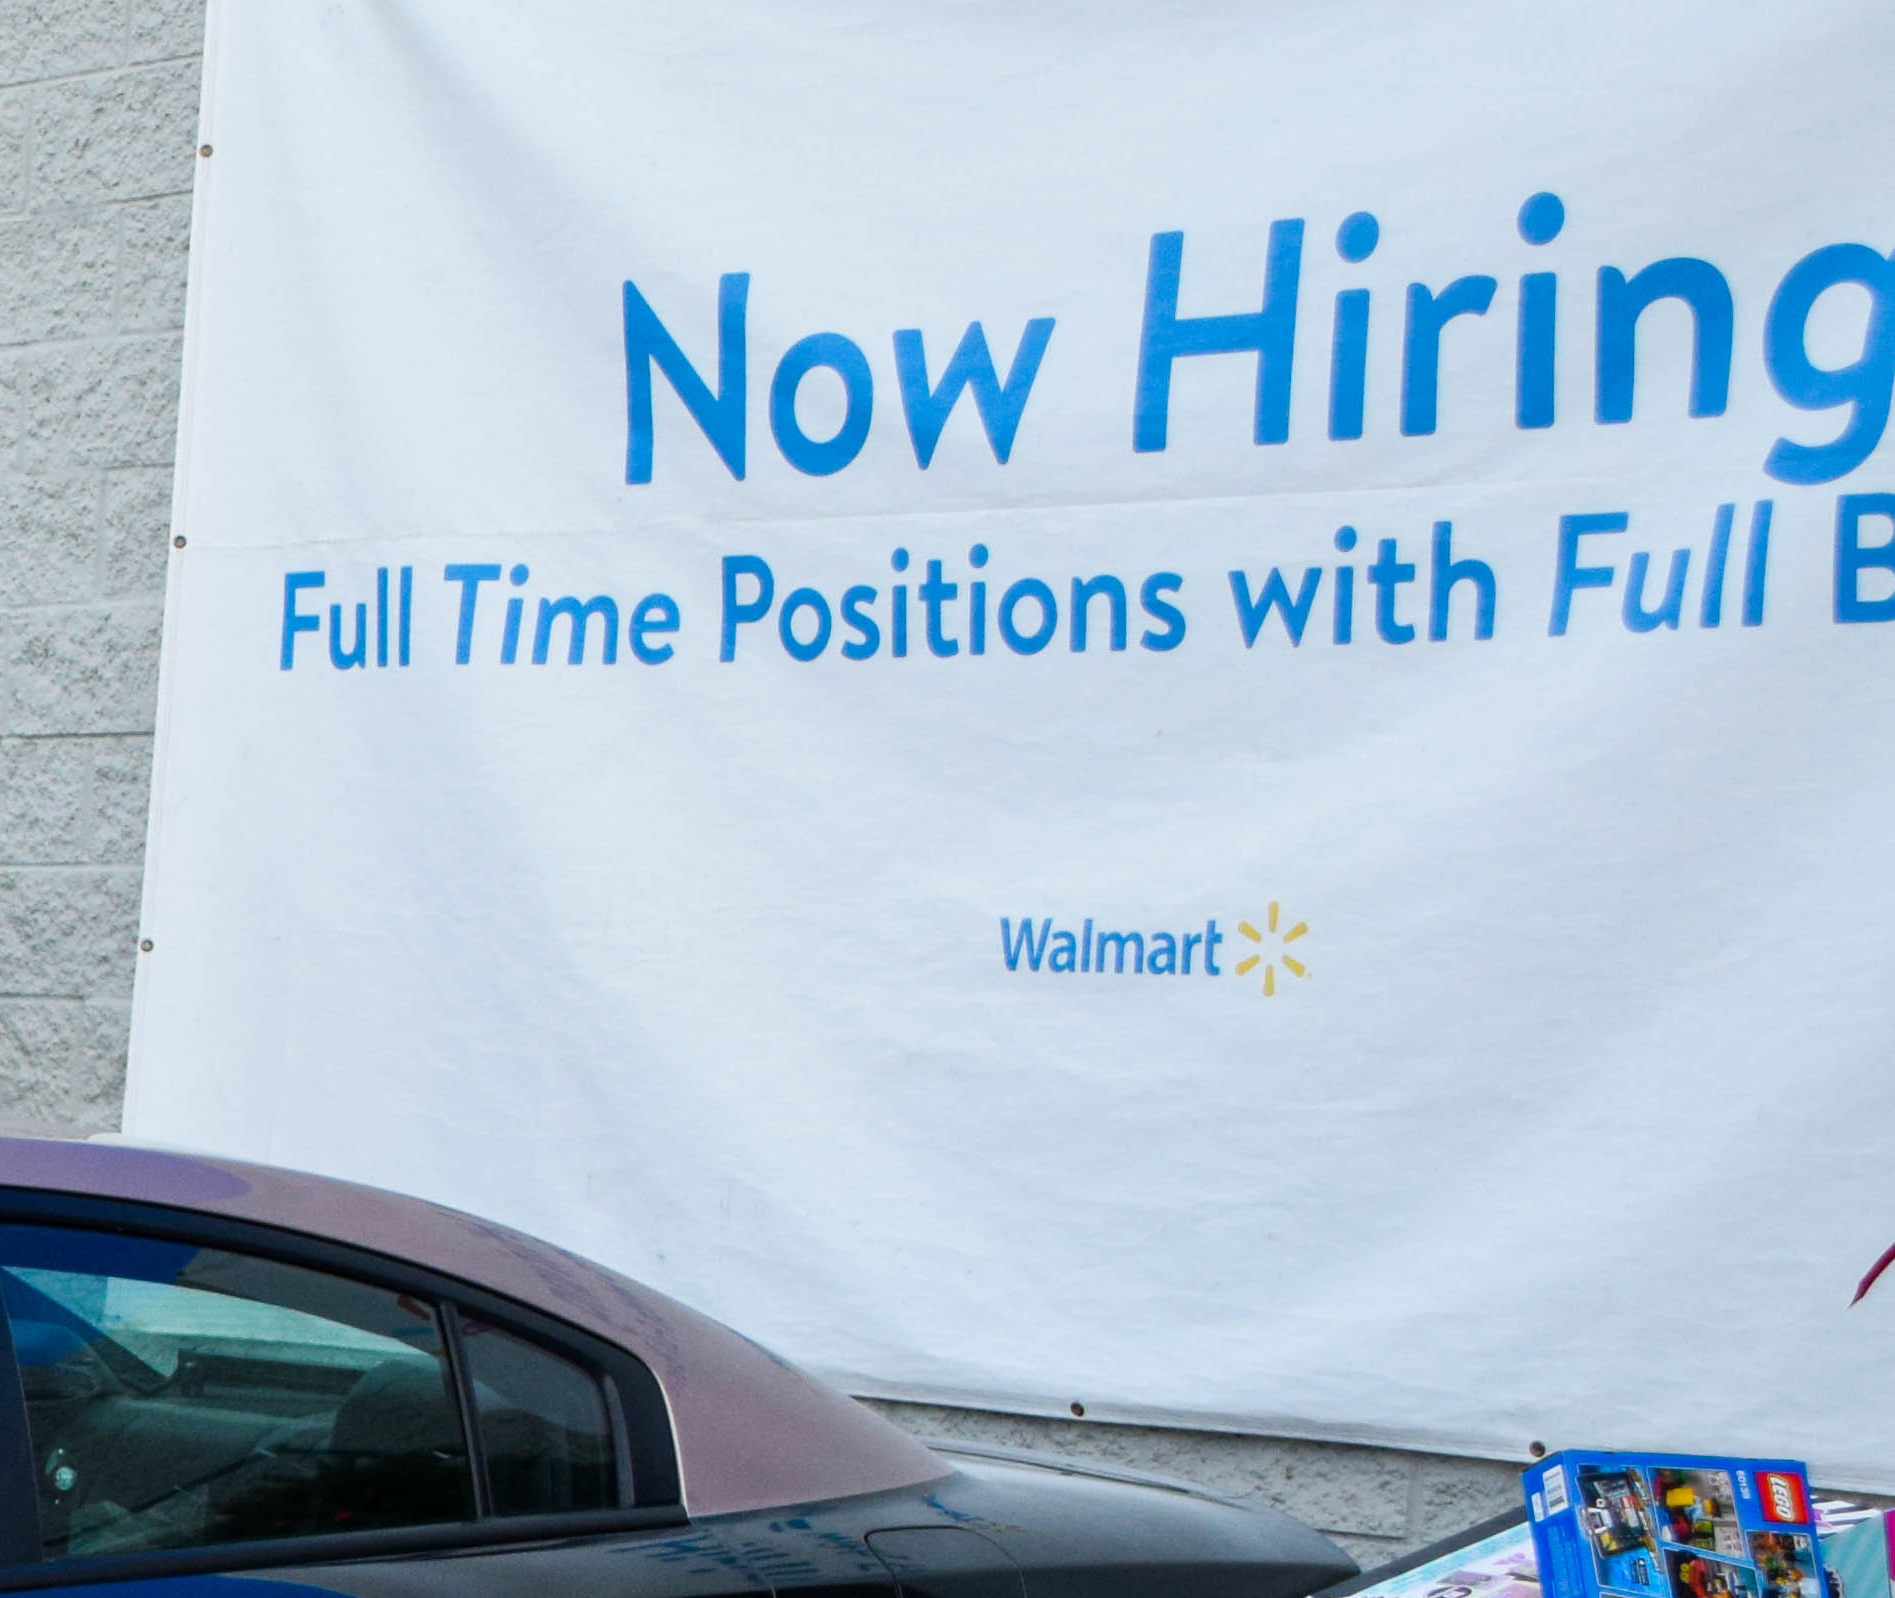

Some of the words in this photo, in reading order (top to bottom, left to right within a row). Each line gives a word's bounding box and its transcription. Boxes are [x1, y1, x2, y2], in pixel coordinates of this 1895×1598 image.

[622, 271, 1057, 486] Now
[1132, 191, 1895, 486] Hiring
[280, 565, 413, 670] Full
[444, 562, 681, 665] Time
[719, 543, 1188, 662] Positions
[1229, 519, 1497, 647] with
[1549, 498, 1774, 636] Full
[998, 914, 1224, 978] Walmart
[1767, 1474, 1795, 1522] LEGO
